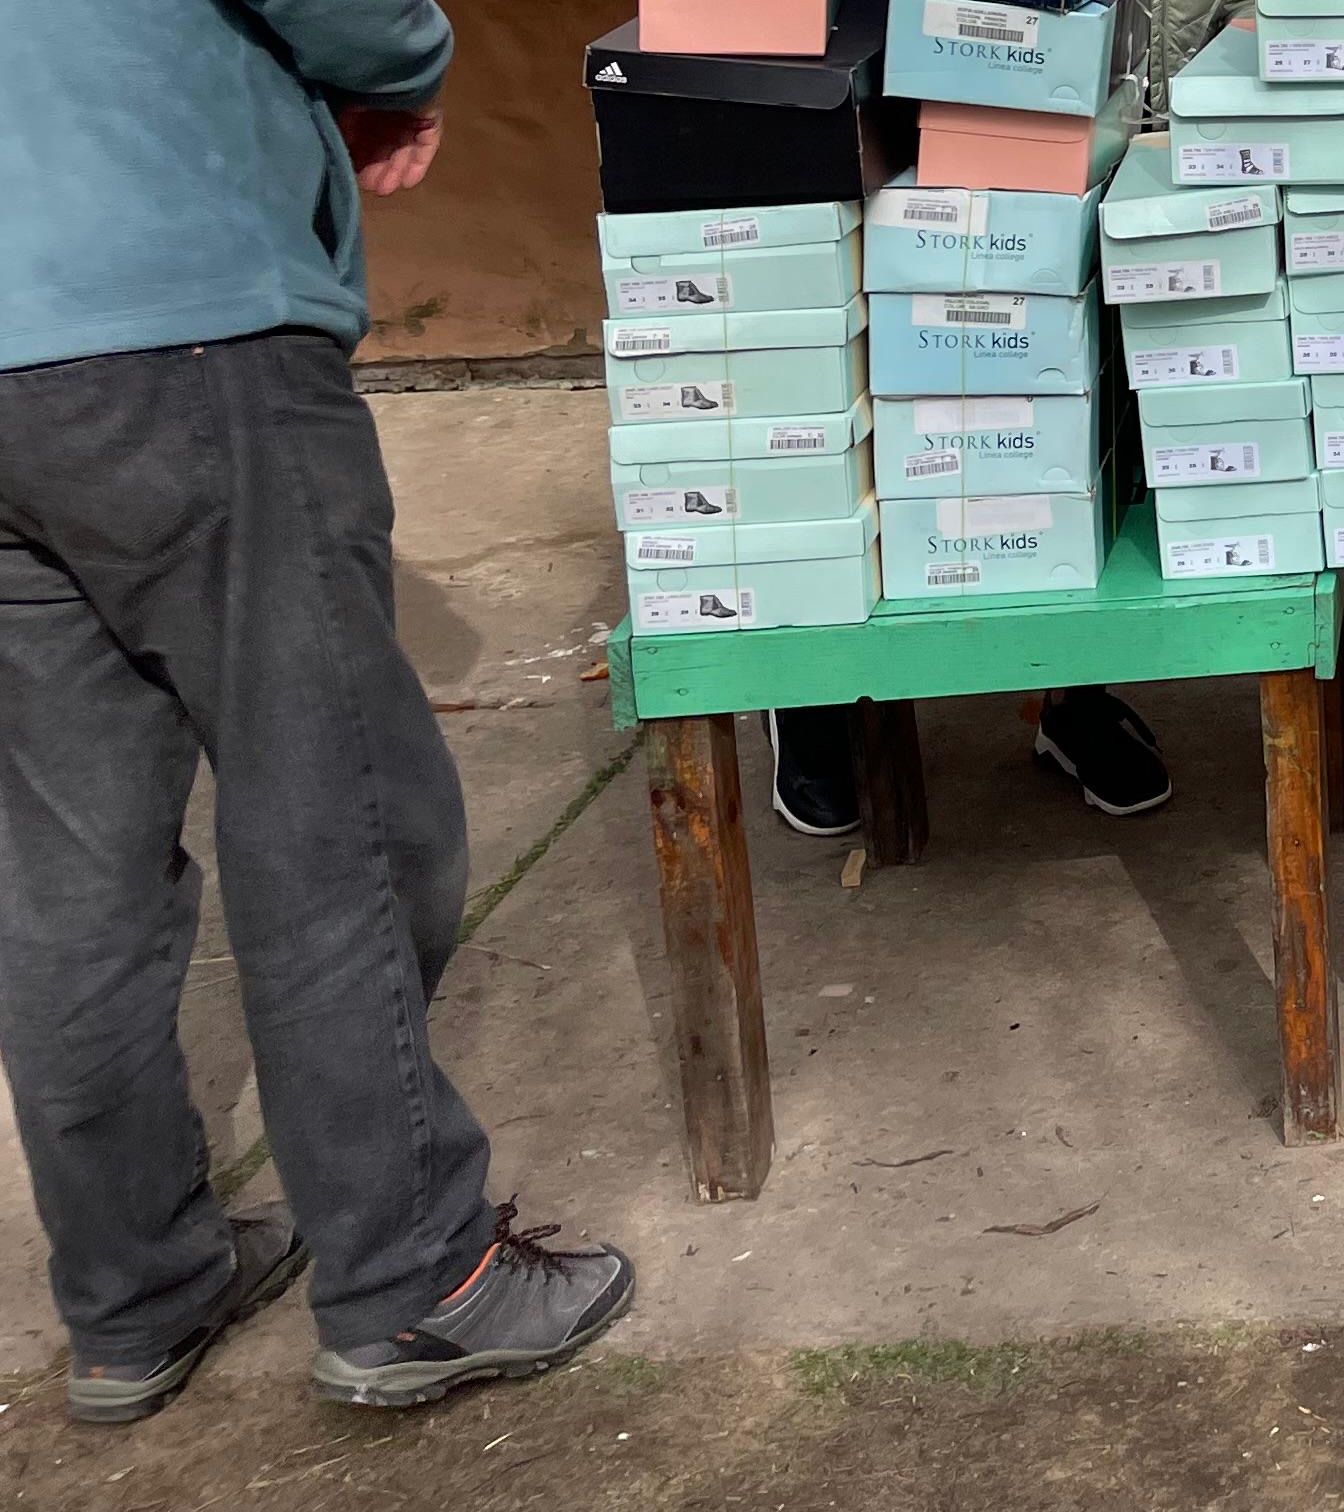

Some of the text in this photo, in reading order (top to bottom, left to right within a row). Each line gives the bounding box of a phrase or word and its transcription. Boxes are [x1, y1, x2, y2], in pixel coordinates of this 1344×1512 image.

[1026, 16, 1039, 25] 27
[1007, 46, 1045, 64] kids
[916, 230, 1027, 251] STORK kids
[1013, 297, 1025, 306] 27
[918, 330, 1030, 349] STORK kids
[924, 432, 1035, 452] STORK kids
[927, 533, 1038, 554] STORK kids
